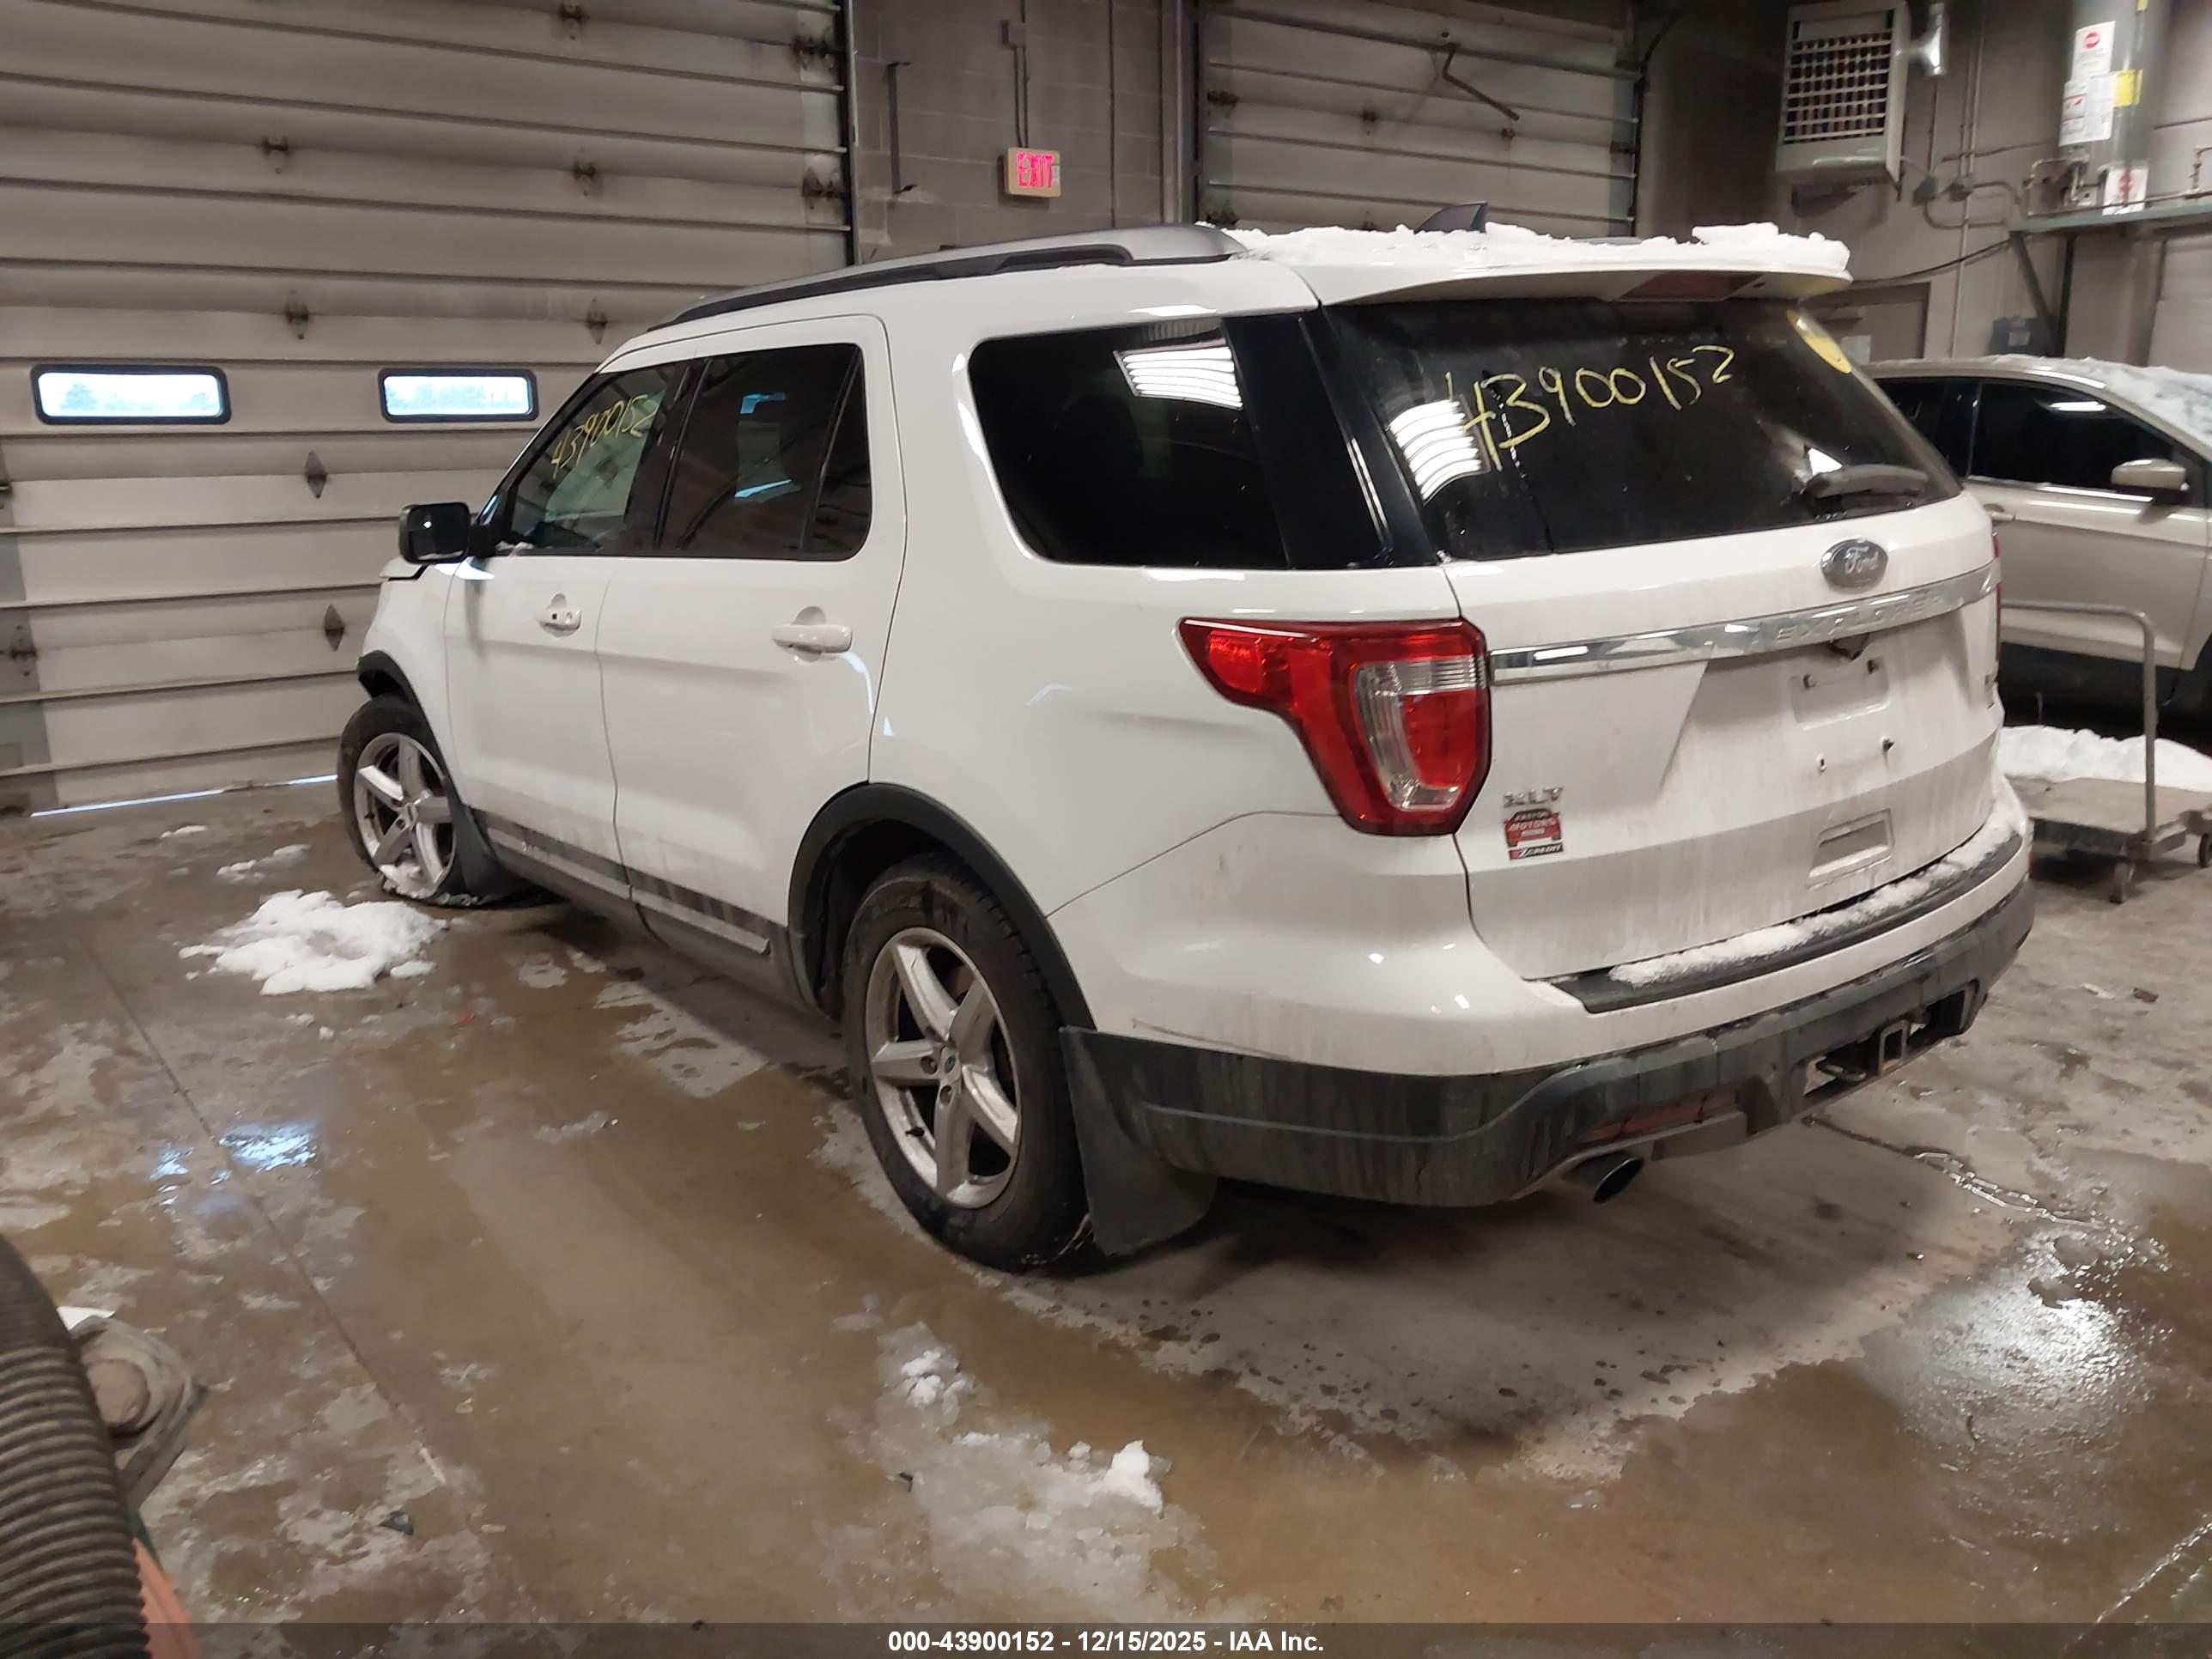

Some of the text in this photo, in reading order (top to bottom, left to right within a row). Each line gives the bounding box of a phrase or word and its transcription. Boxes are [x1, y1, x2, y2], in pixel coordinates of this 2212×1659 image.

[1017, 151, 1053, 188] EXIT
[1445, 345, 1735, 472] 43900152
[1844, 545, 1879, 574] Ford
[1504, 787, 1564, 808] XLT
